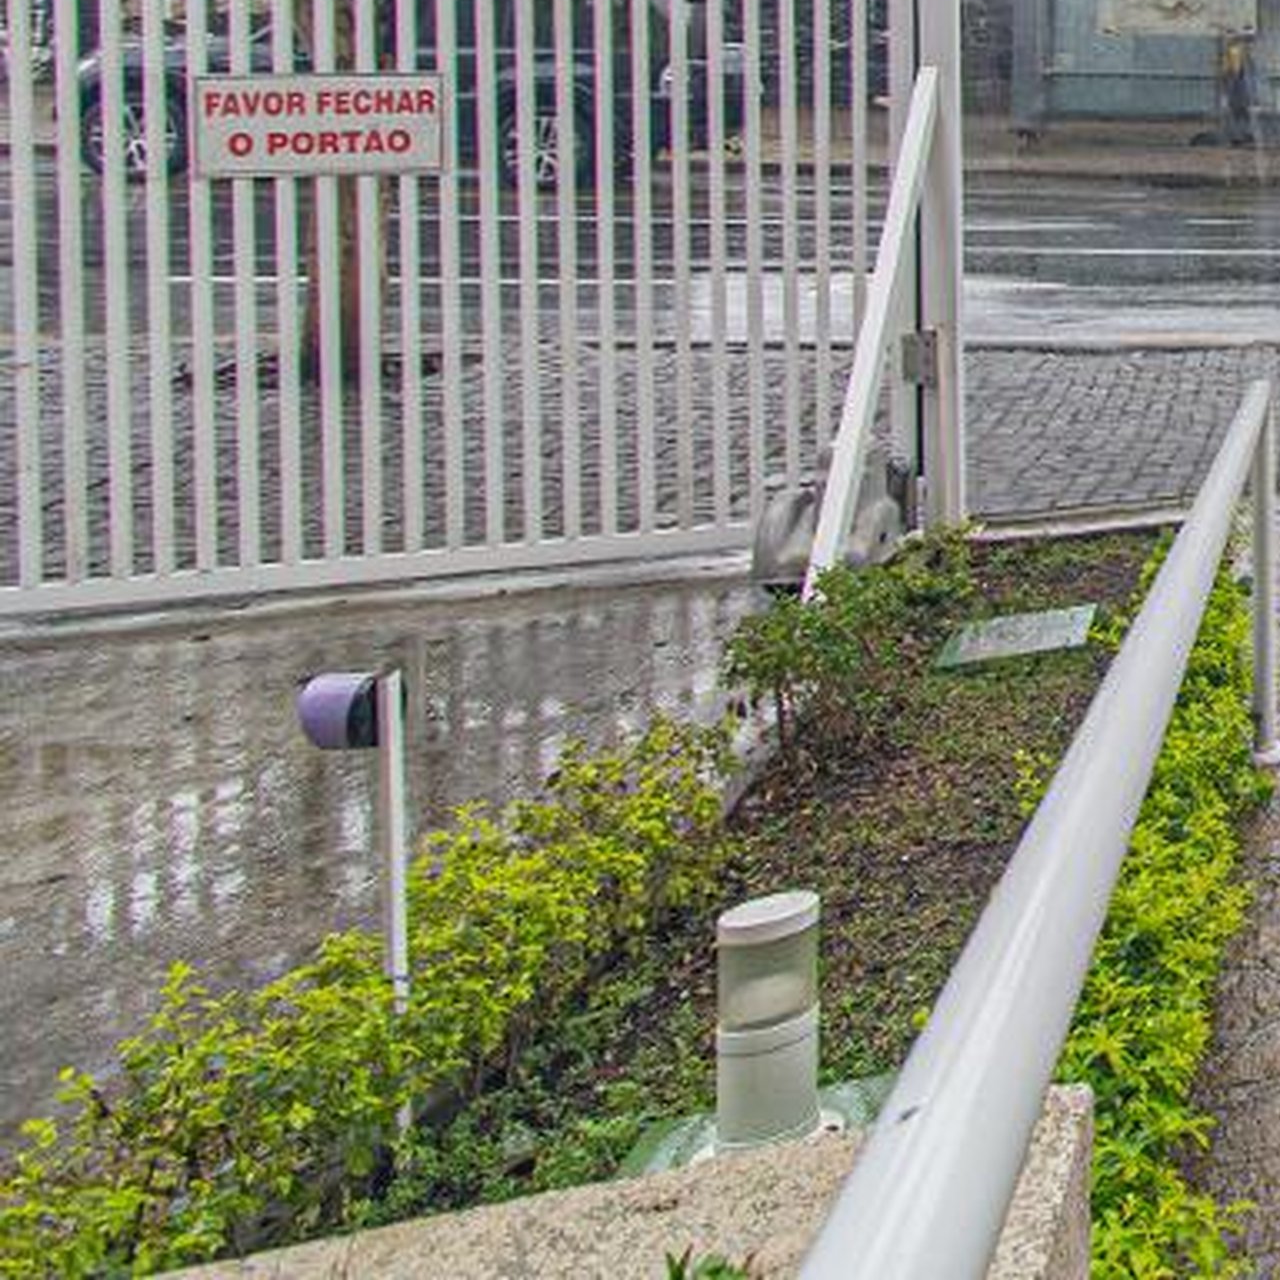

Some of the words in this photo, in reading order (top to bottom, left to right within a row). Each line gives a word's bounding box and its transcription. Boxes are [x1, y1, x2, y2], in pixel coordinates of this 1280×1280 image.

[204, 91, 307, 117] FAVOR
[317, 88, 436, 115] FECHAR
[227, 131, 253, 157] O
